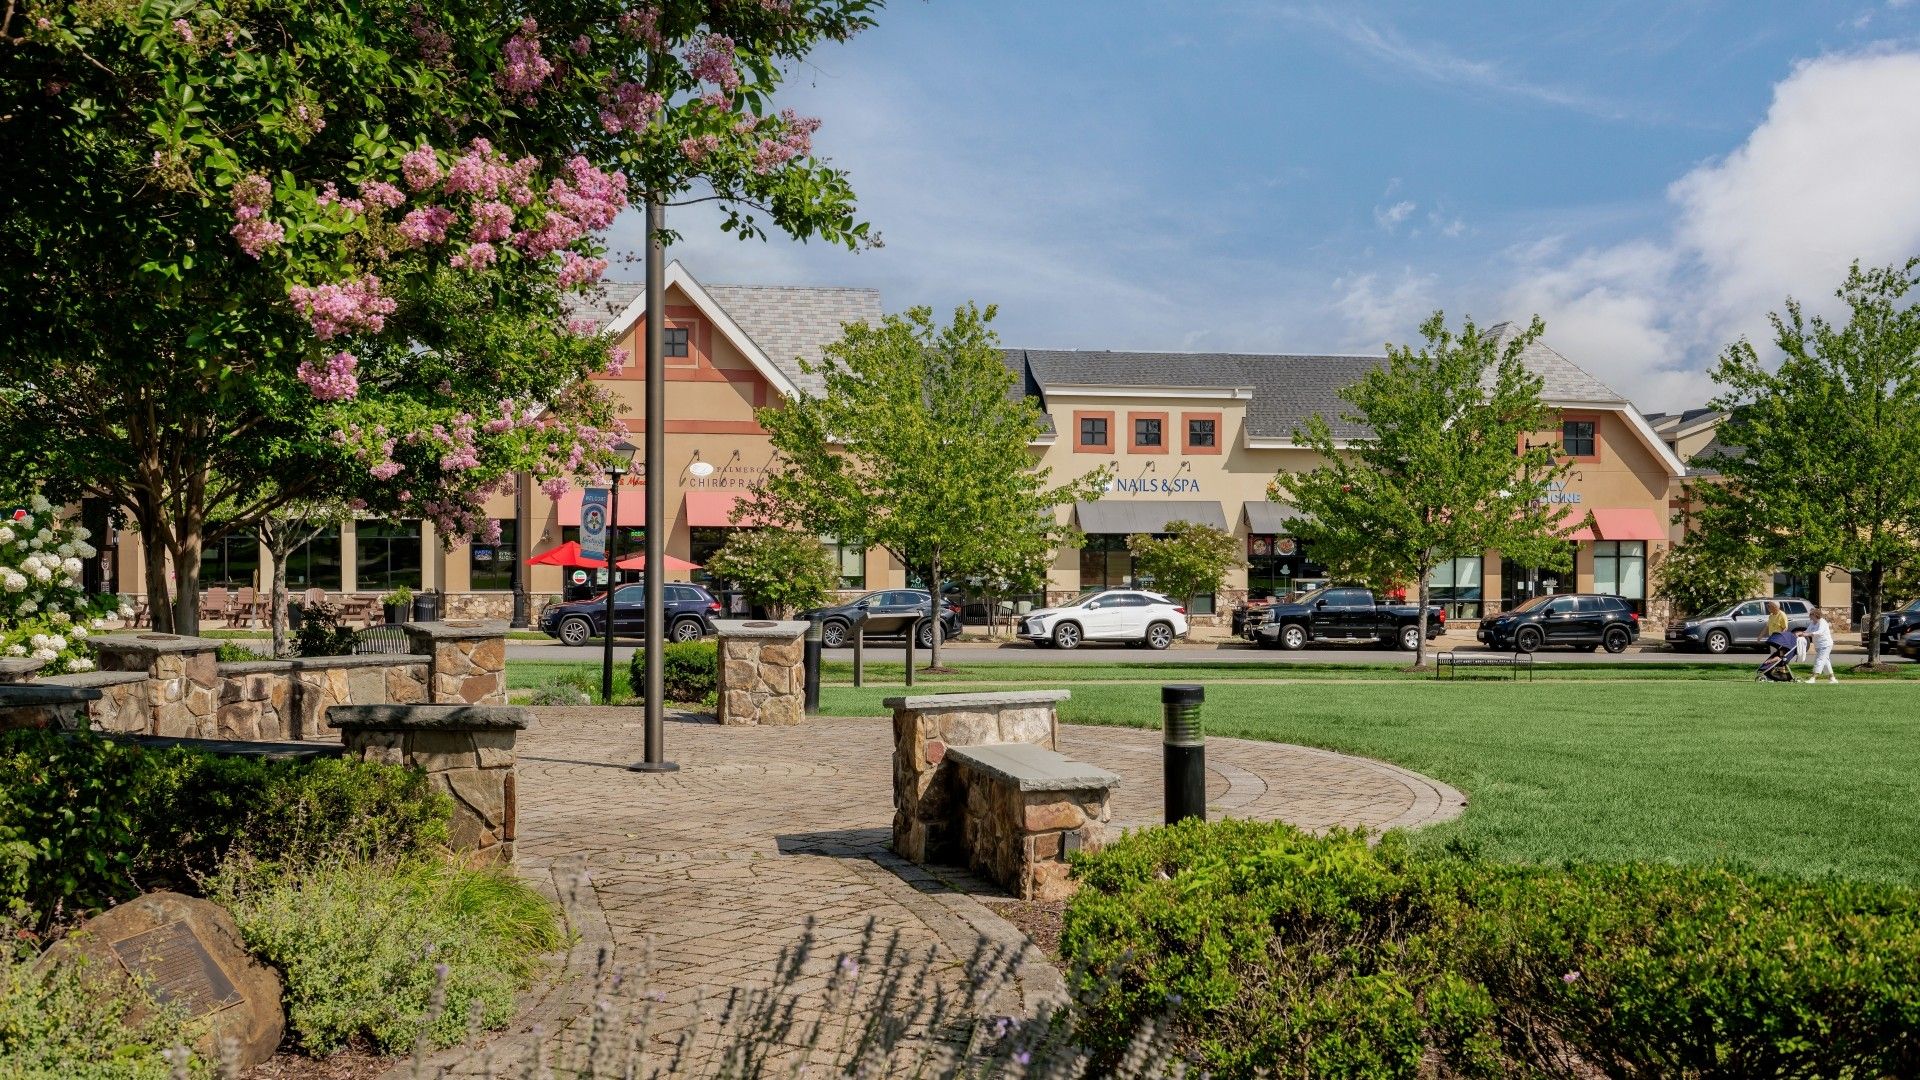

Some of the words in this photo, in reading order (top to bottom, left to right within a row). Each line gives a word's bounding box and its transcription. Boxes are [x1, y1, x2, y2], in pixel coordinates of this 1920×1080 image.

[1117, 478, 1158, 492] NAILS
[1161, 478, 1171, 492] &
[1173, 478, 1200, 492] SPA
